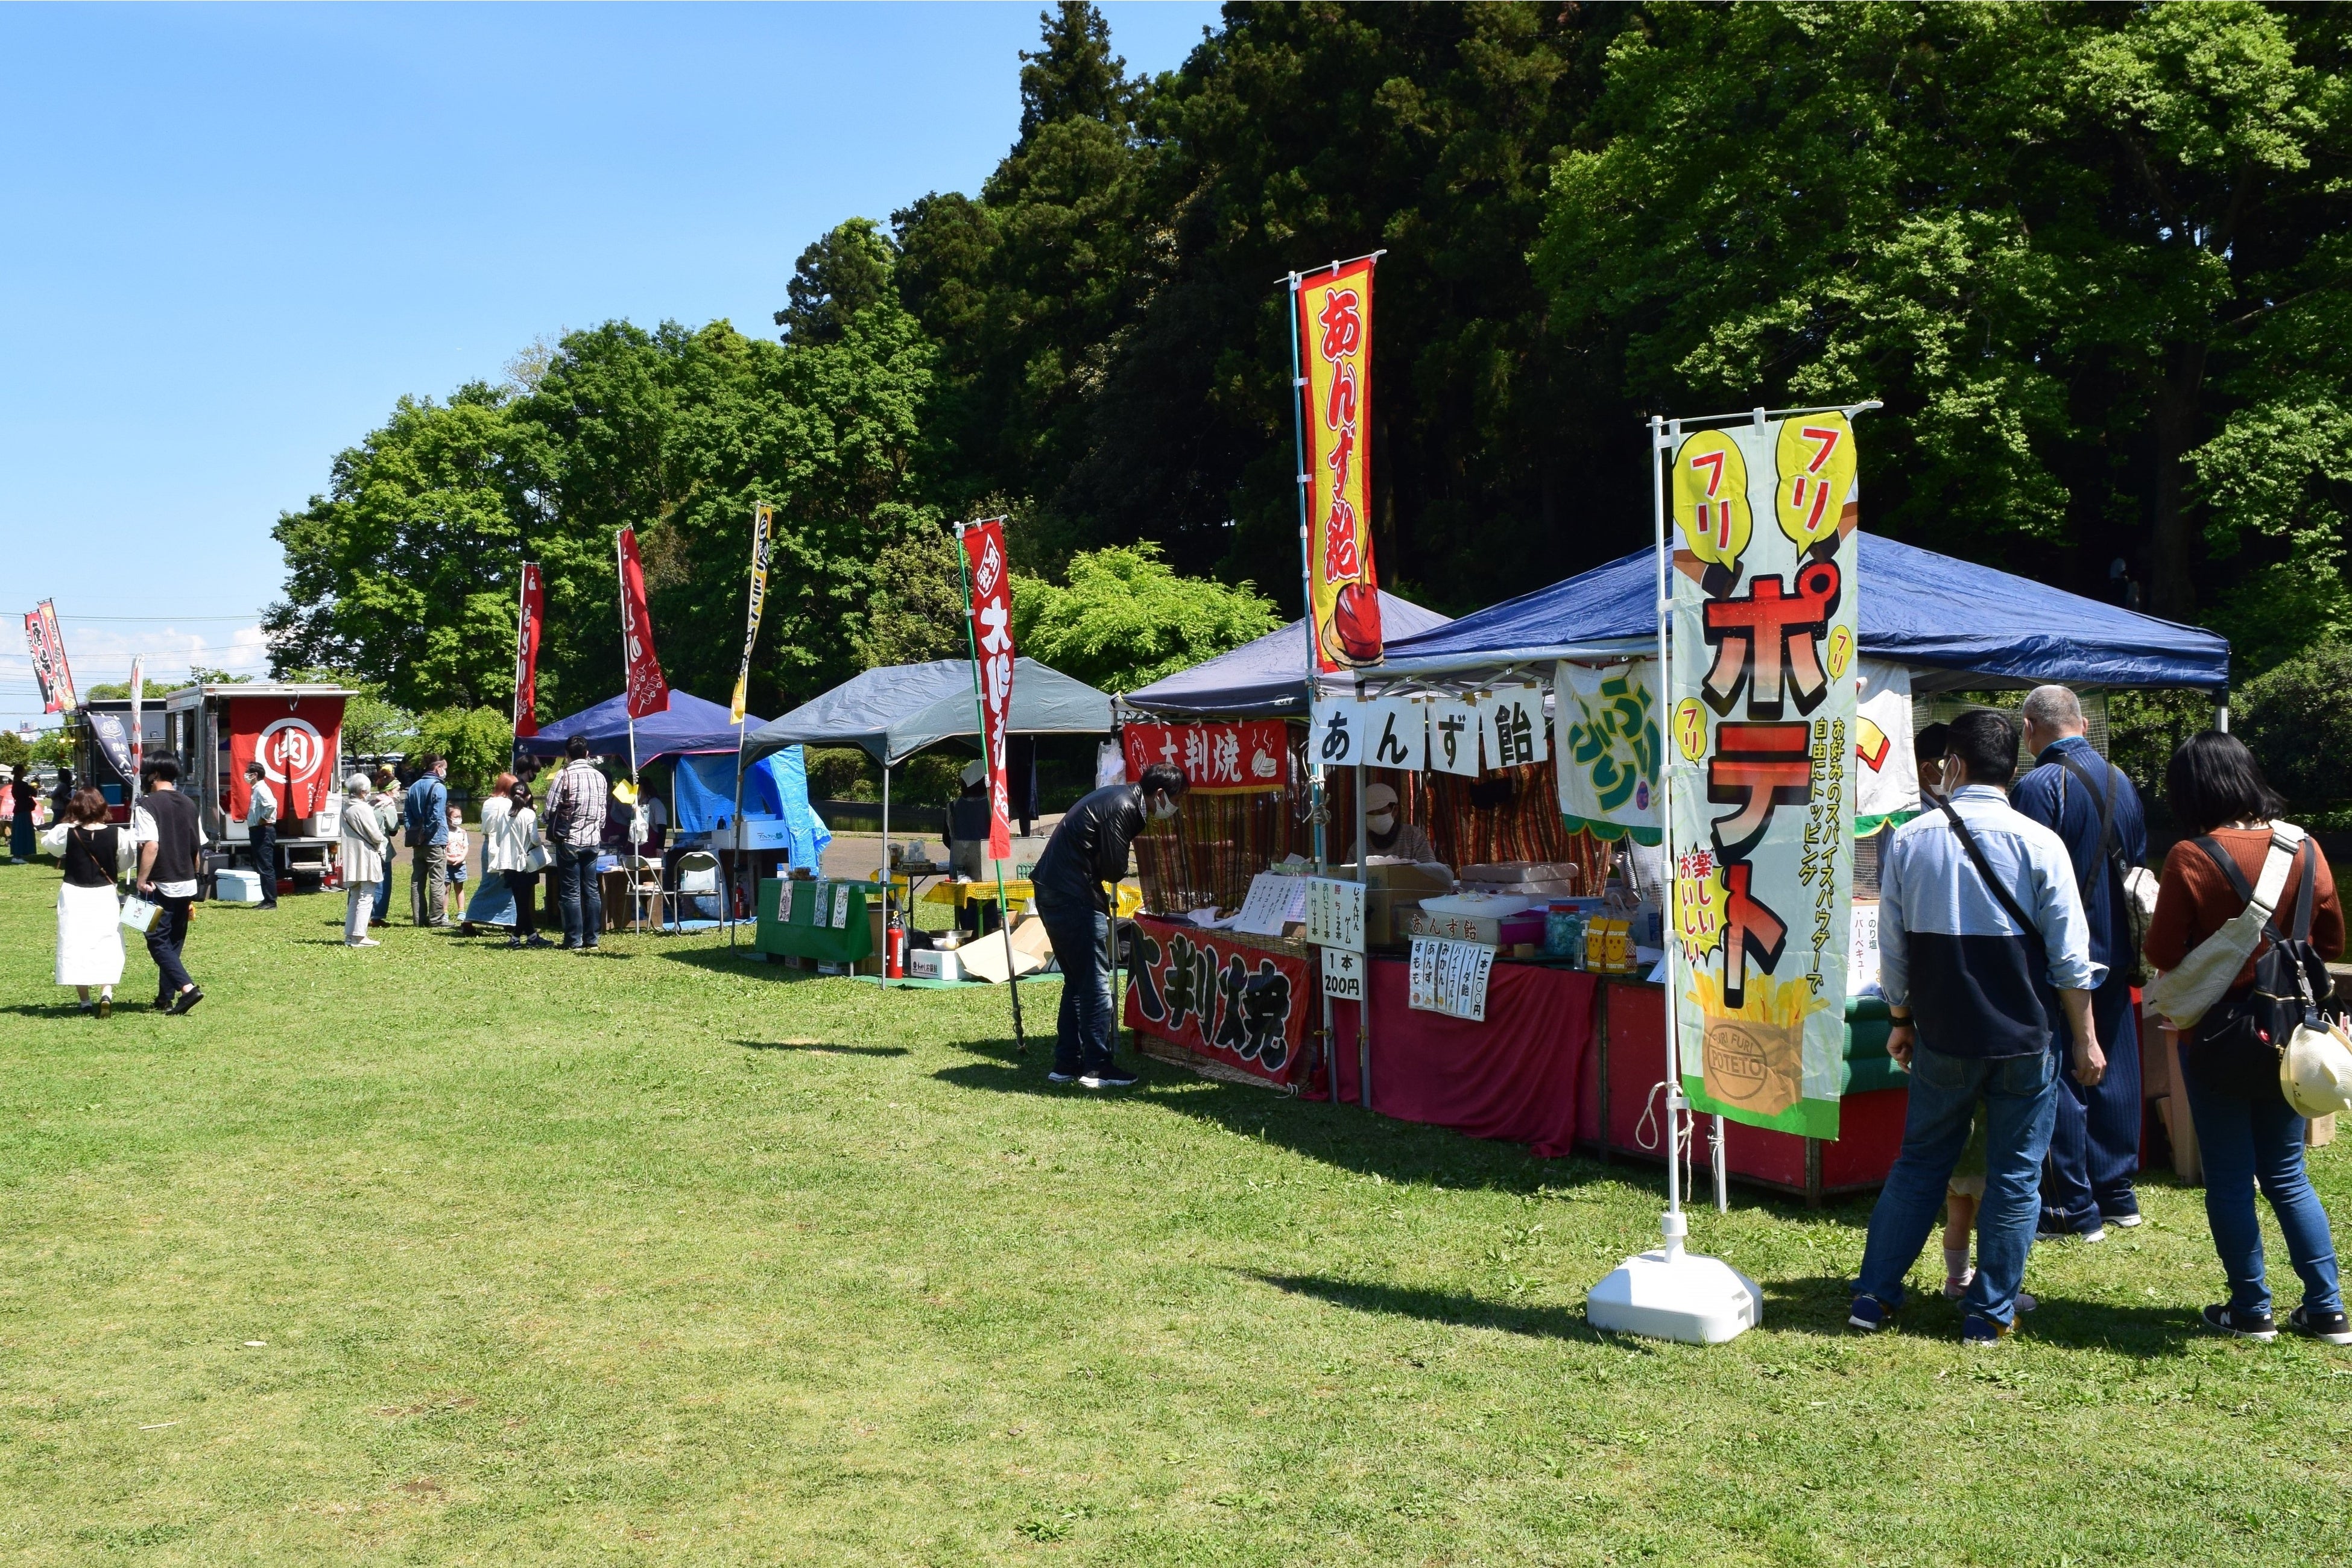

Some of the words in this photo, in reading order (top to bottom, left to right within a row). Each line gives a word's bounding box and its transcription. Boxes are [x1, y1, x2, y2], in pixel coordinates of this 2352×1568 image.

[1690, 450, 1731, 551] フリ
[1791, 426, 1841, 533] フリ
[1833, 634, 1847, 673] フリ
[274, 727, 309, 770] 肉
[1321, 701, 1534, 769] あんず飴
[1683, 709, 1697, 754] フリ
[1703, 560, 1839, 1006] ポテト
[1799, 716, 1829, 887] 自由にトッピング
[1806, 719, 1845, 995] お好みのスパイスパウダーで
[1680, 855, 1700, 963] おいしい
[1692, 849, 1716, 934] 楽しい
[1412, 914, 1478, 941] あんず飴
[1412, 941, 1423, 985] すもも
[1424, 942, 1435, 984] あんず
[1438, 943, 1449, 985] みかん
[1325, 975, 1360, 996] 200円
[1711, 1049, 1762, 1076] POTETO
[1731, 1032, 1753, 1054] FURI
